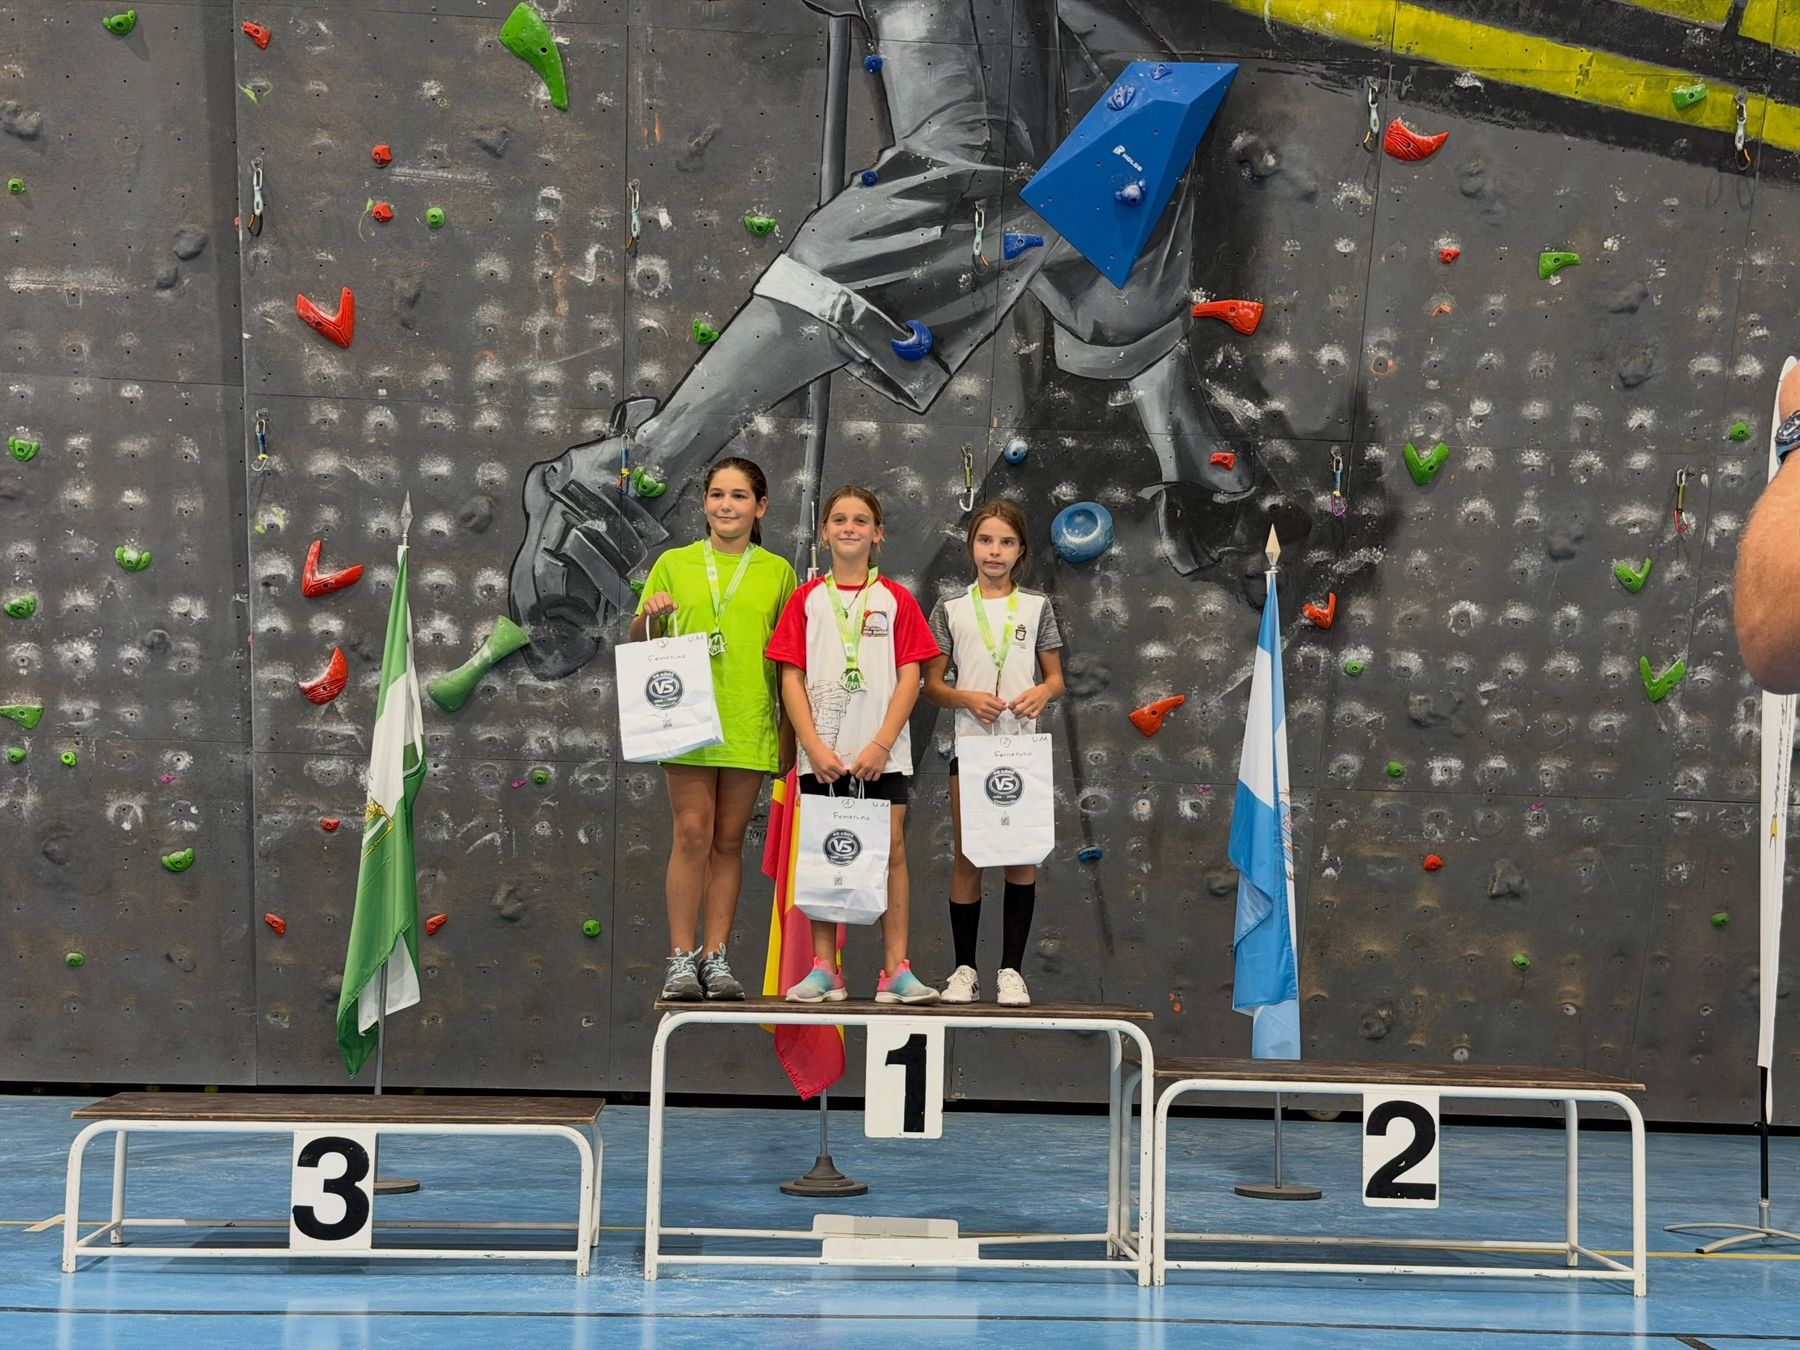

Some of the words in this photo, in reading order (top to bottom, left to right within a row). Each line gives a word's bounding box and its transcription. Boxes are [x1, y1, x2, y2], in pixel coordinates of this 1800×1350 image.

[1121, 153, 1143, 172] HOLDS
[653, 680, 675, 695] VS
[994, 777, 1015, 791] VS
[832, 839, 854, 853] VS
[885, 1034, 927, 1133] 1
[1365, 1100, 1437, 1201] 2
[292, 1136, 370, 1241] 3
